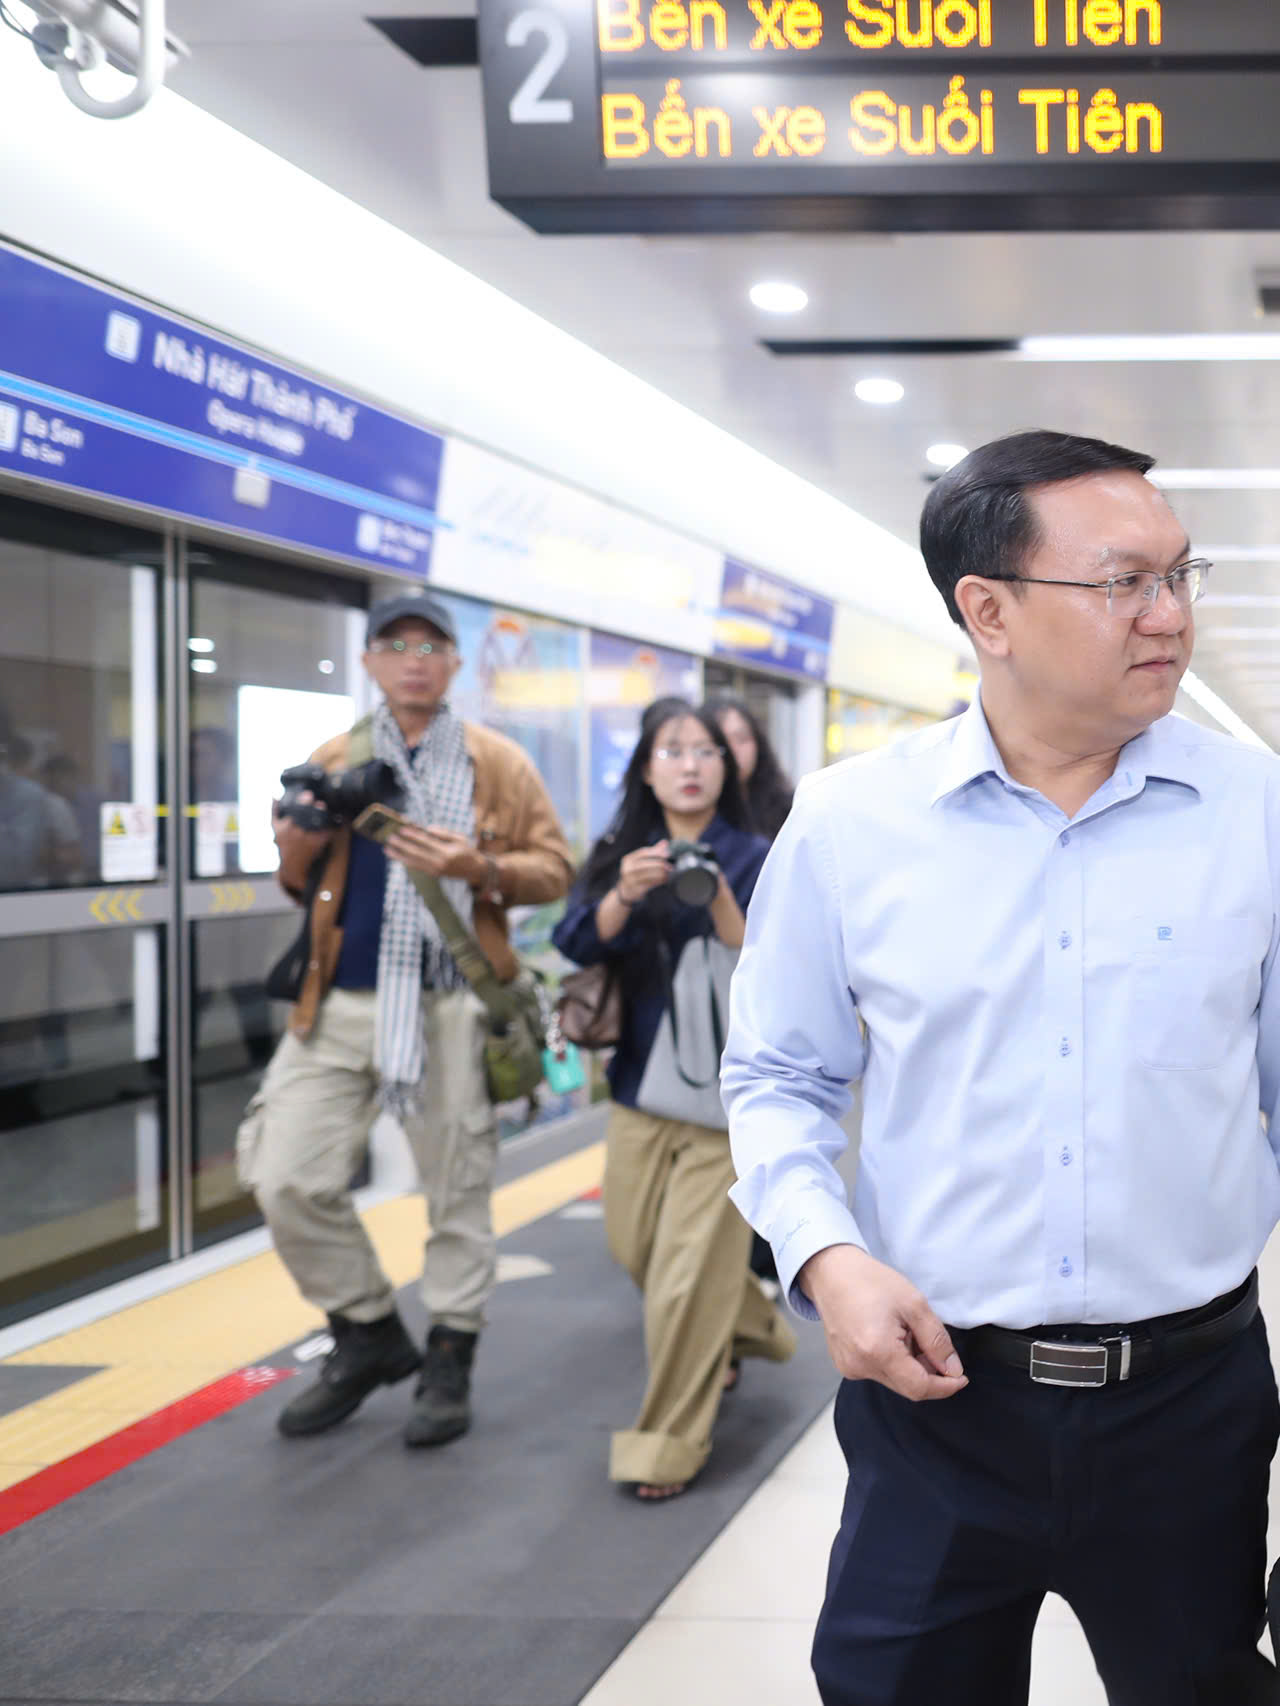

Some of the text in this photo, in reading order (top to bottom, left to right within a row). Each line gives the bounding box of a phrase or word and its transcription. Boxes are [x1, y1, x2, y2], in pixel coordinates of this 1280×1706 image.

[505, 9, 574, 123] 2
[748, 0, 823, 50] xe
[602, 78, 732, 158] Bến
[751, 106, 825, 157] xe
[848, 75, 994, 155] Suối
[1018, 88, 1162, 154] Tiên
